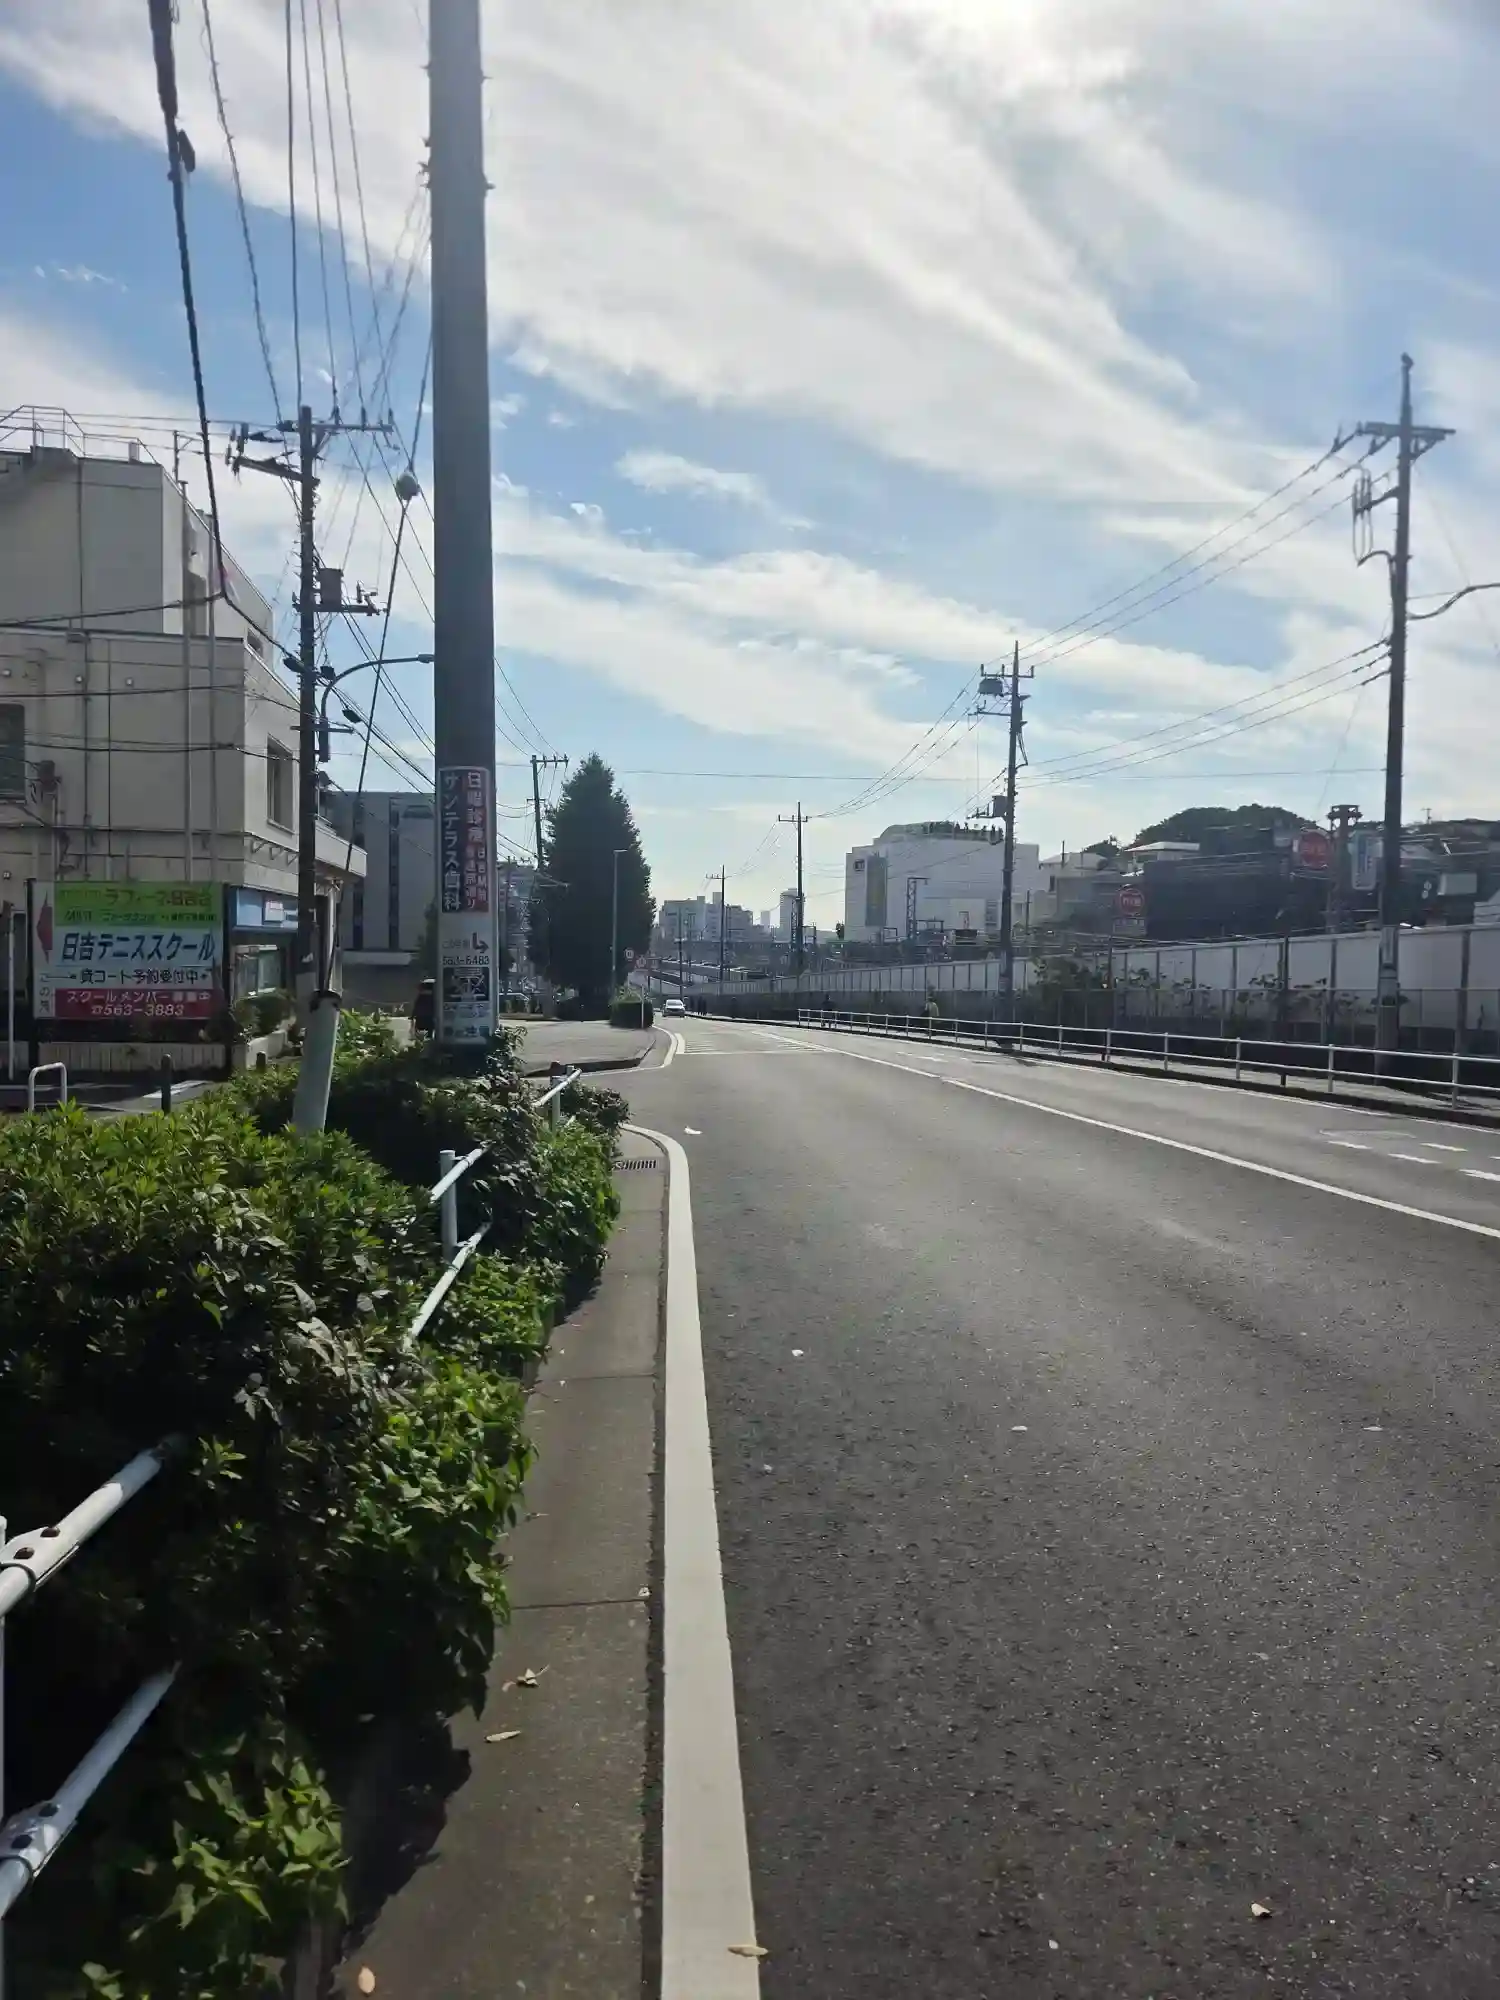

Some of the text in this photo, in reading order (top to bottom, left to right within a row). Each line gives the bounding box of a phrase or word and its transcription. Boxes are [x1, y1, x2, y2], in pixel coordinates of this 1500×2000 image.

[444, 772, 461, 911] サンテラス歯科
[62, 932, 215, 961] 日吉テニススクール
[80, 969, 198, 985] 貸コート予約受付中
[103, 1004, 184, 1016] 563-3883
